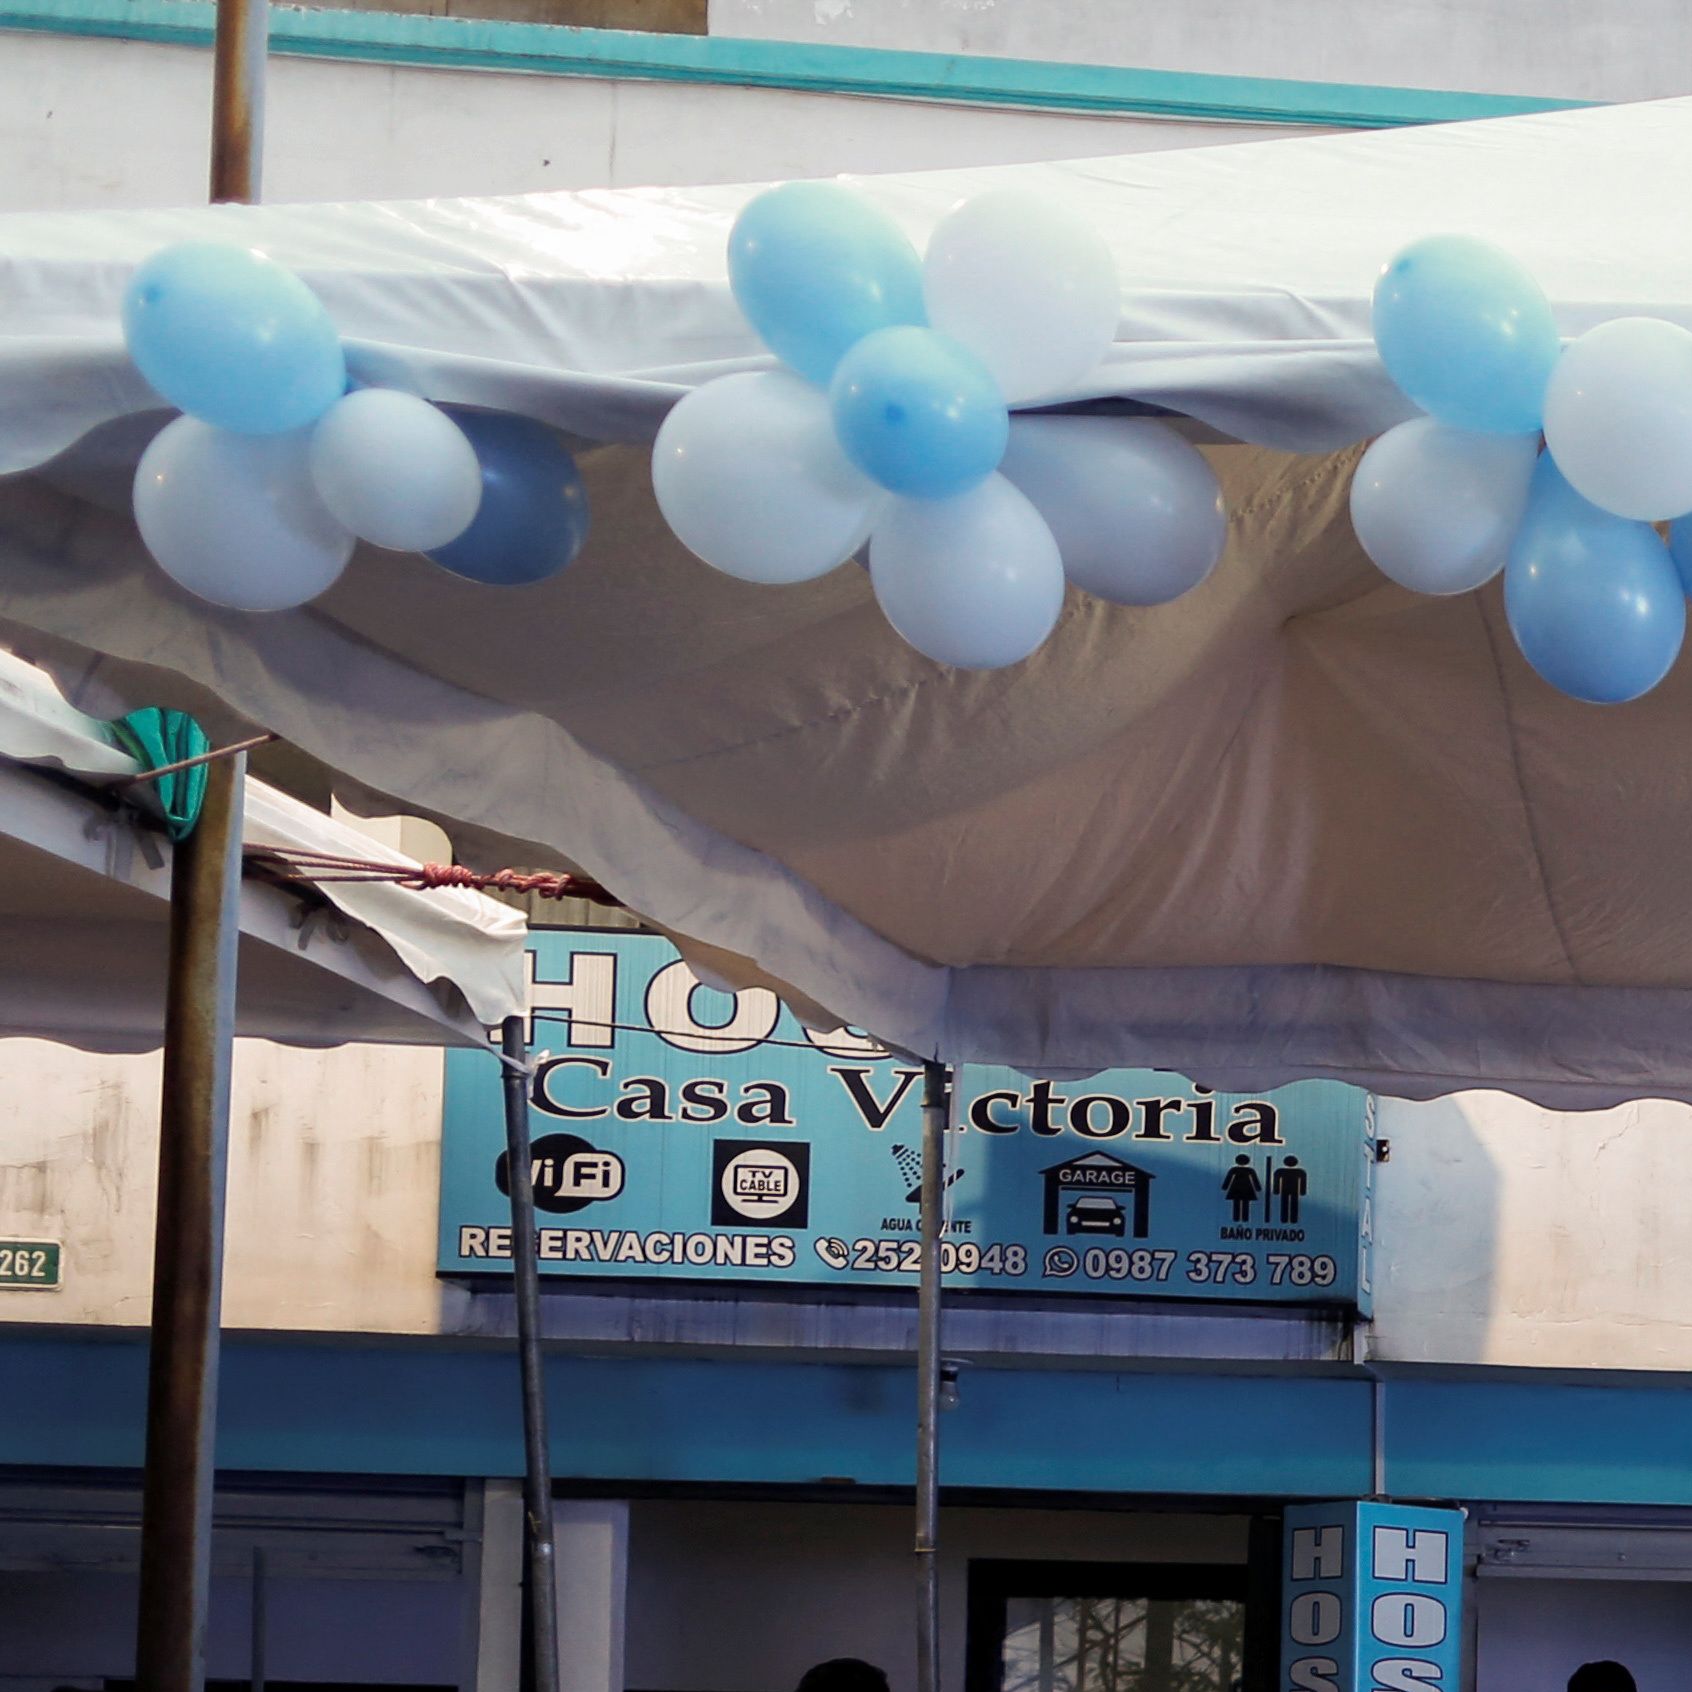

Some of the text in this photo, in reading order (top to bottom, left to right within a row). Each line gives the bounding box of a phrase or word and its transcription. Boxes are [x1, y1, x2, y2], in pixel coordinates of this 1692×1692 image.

[527, 1054, 796, 1126] Casa
[748, 1169, 774, 1179] TV
[1059, 1168, 1136, 1185] GARAGE
[739, 1178, 782, 1193] CABLE
[881, 1217, 913, 1232] AGUA
[1220, 1226, 1305, 1243] BAÑO PRIVADO
[459, 1226, 796, 1268] REERVACIONES
[1084, 1247, 1177, 1281] 0987
[1187, 1251, 1256, 1285] 373
[1268, 1253, 1336, 1288] 789
